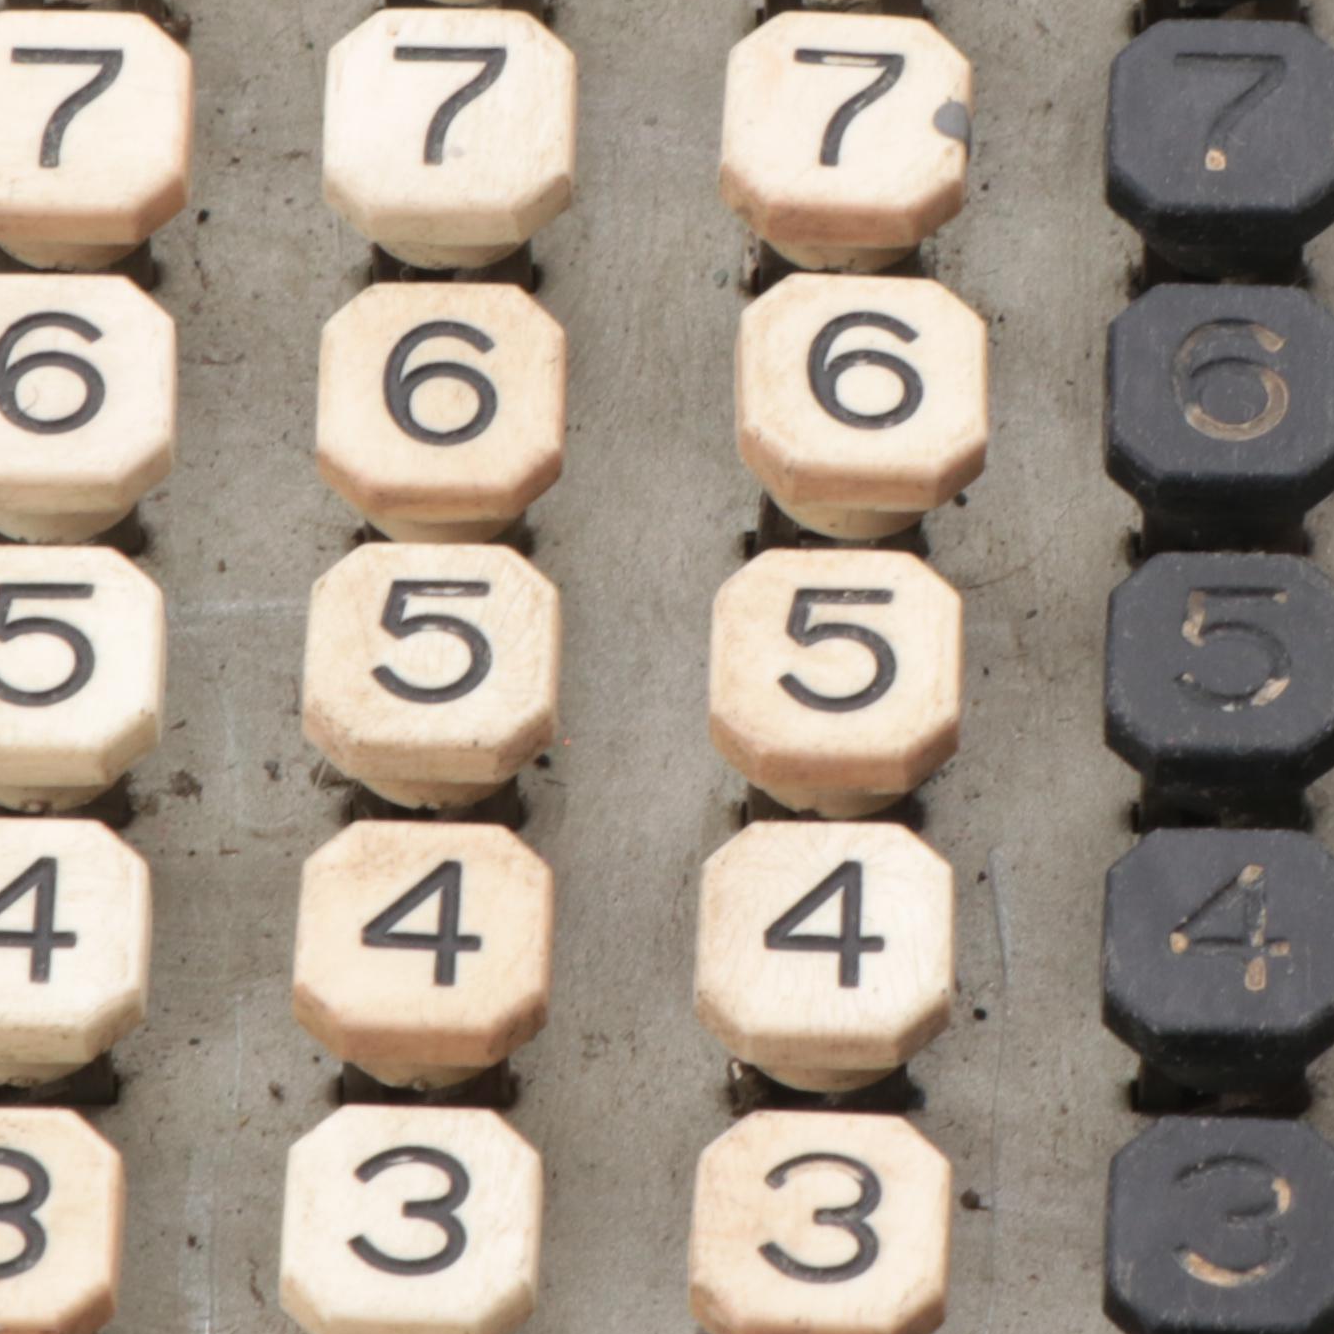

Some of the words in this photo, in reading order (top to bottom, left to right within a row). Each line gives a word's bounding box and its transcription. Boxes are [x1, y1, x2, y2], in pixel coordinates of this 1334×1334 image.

[11, 47, 124, 169] 7
[393, 45, 507, 166] 7
[794, 48, 906, 166] 7
[1173, 52, 1288, 171] 7
[382, 319, 498, 446] 6
[806, 310, 924, 430] 6
[1171, 318, 1289, 441] 6
[371, 579, 493, 704] 5
[778, 588, 898, 713] 5
[1173, 586, 1291, 710] 5
[361, 860, 482, 987] 4
[763, 860, 886, 988] 4
[1169, 864, 1291, 991] 4
[347, 1145, 472, 1276] 3
[757, 1152, 883, 1284] 3
[1172, 1155, 1291, 1287] 3
